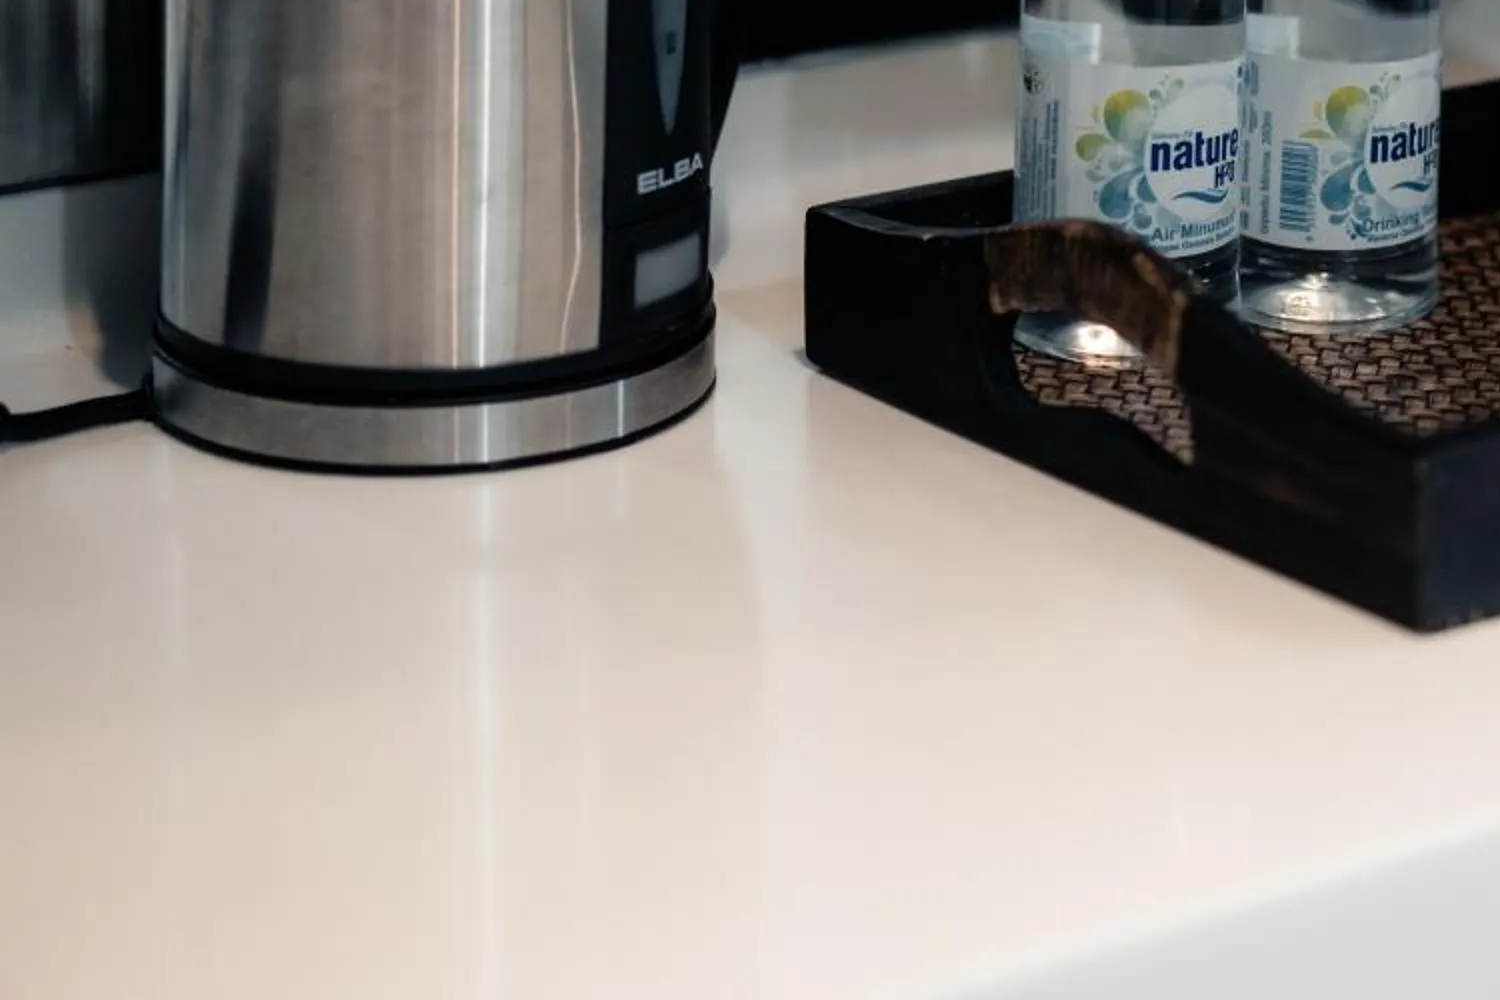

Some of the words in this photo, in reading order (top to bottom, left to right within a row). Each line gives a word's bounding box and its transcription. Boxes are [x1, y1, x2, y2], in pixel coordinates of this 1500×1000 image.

[1151, 128, 1239, 171] nature
[637, 152, 704, 195] ELBA
[1152, 227, 1176, 241] Air
